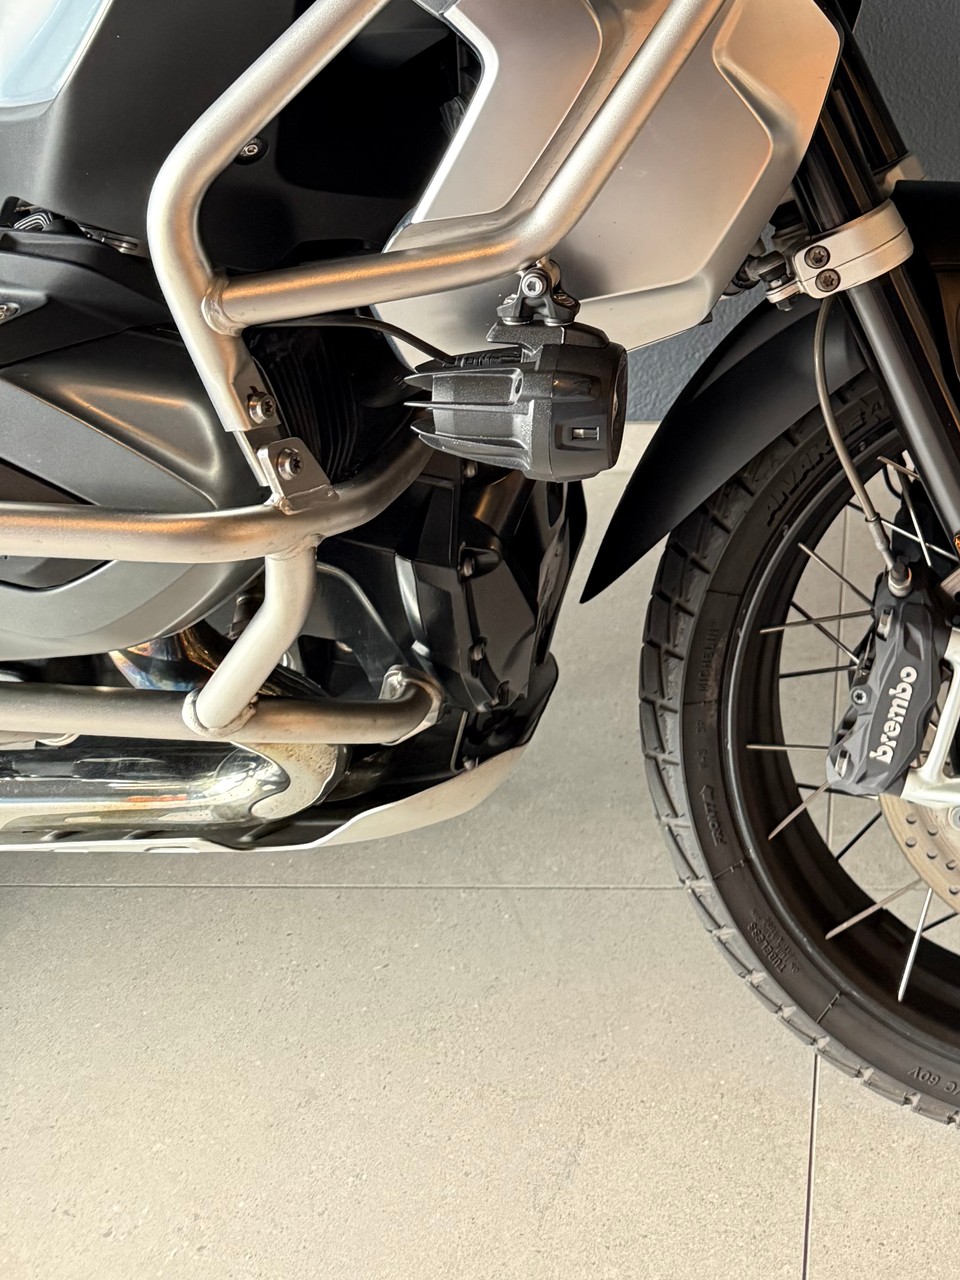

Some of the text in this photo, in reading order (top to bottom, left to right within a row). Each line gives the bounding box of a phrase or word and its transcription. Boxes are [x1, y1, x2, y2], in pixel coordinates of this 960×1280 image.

[869, 665, 918, 765] brembo
[747, 920, 787, 974] TUBELESS
[907, 1066, 941, 1086] 60V
